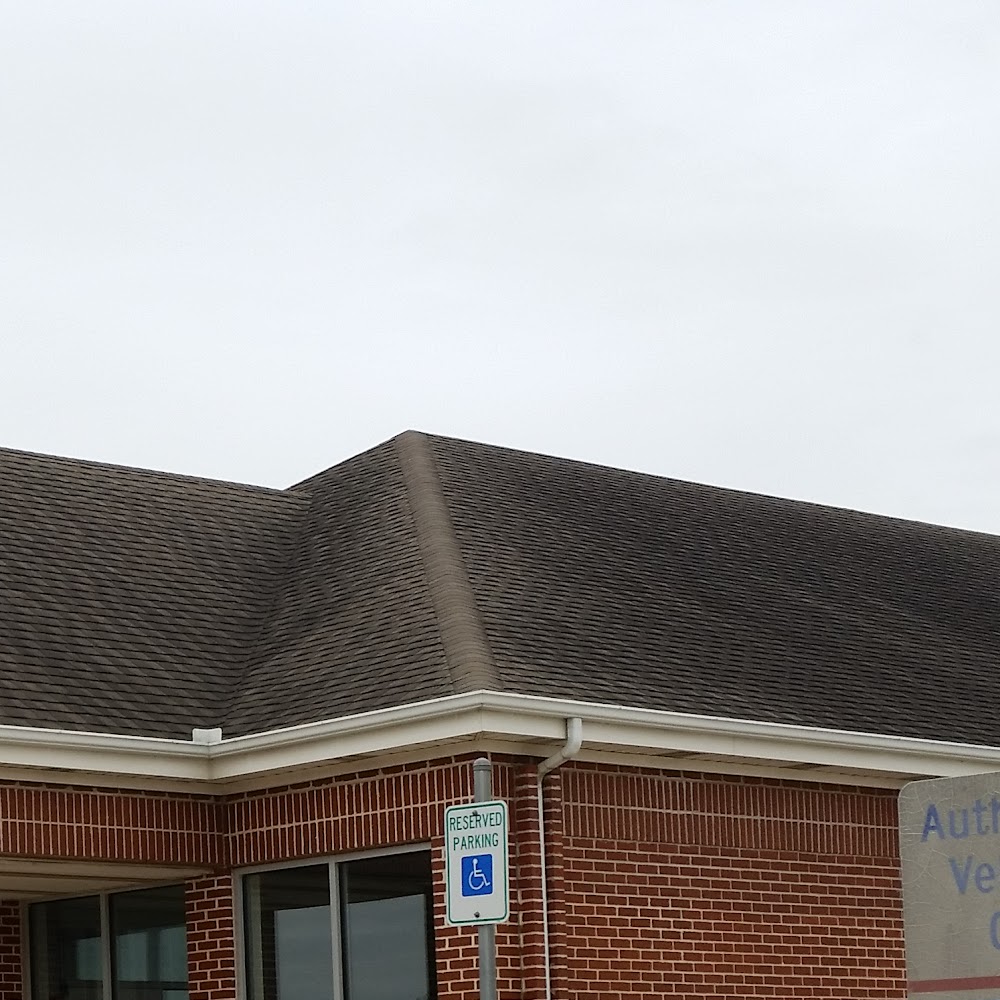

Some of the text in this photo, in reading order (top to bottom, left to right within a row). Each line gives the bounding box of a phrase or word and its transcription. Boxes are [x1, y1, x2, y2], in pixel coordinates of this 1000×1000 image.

[450, 812, 502, 831] RESERVED
[453, 832, 499, 851] PARKING
[949, 855, 1000, 895] Ve
